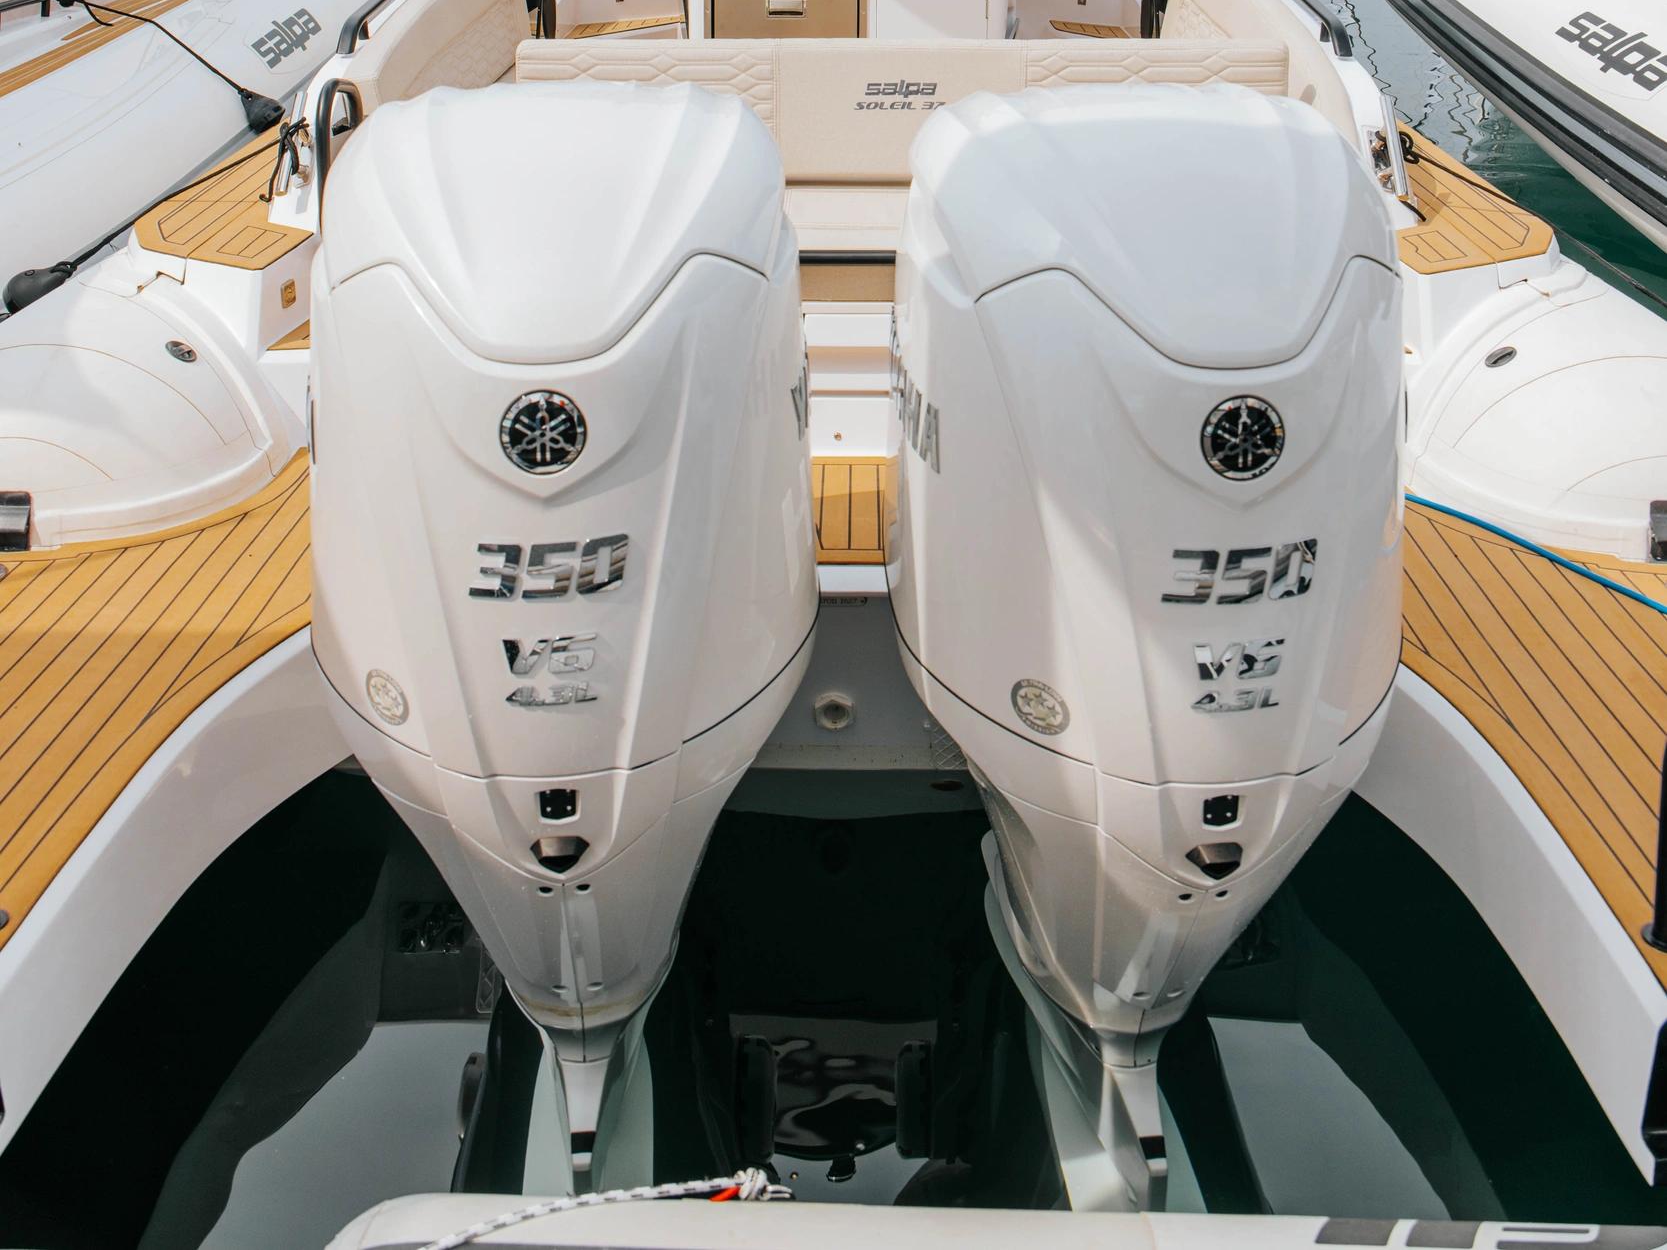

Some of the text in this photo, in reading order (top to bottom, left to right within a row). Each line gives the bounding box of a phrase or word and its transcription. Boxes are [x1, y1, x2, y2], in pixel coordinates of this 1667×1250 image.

[250, 8, 321, 69] salpa
[1555, 11, 1667, 91] salpa
[853, 101, 946, 111] SOLEIL 37
[864, 79, 937, 98] salpa
[468, 533, 629, 599] 350
[1161, 538, 1318, 605] 350
[502, 632, 598, 675] V6
[1193, 638, 1285, 680] V6
[1191, 688, 1279, 713] 4.3L
